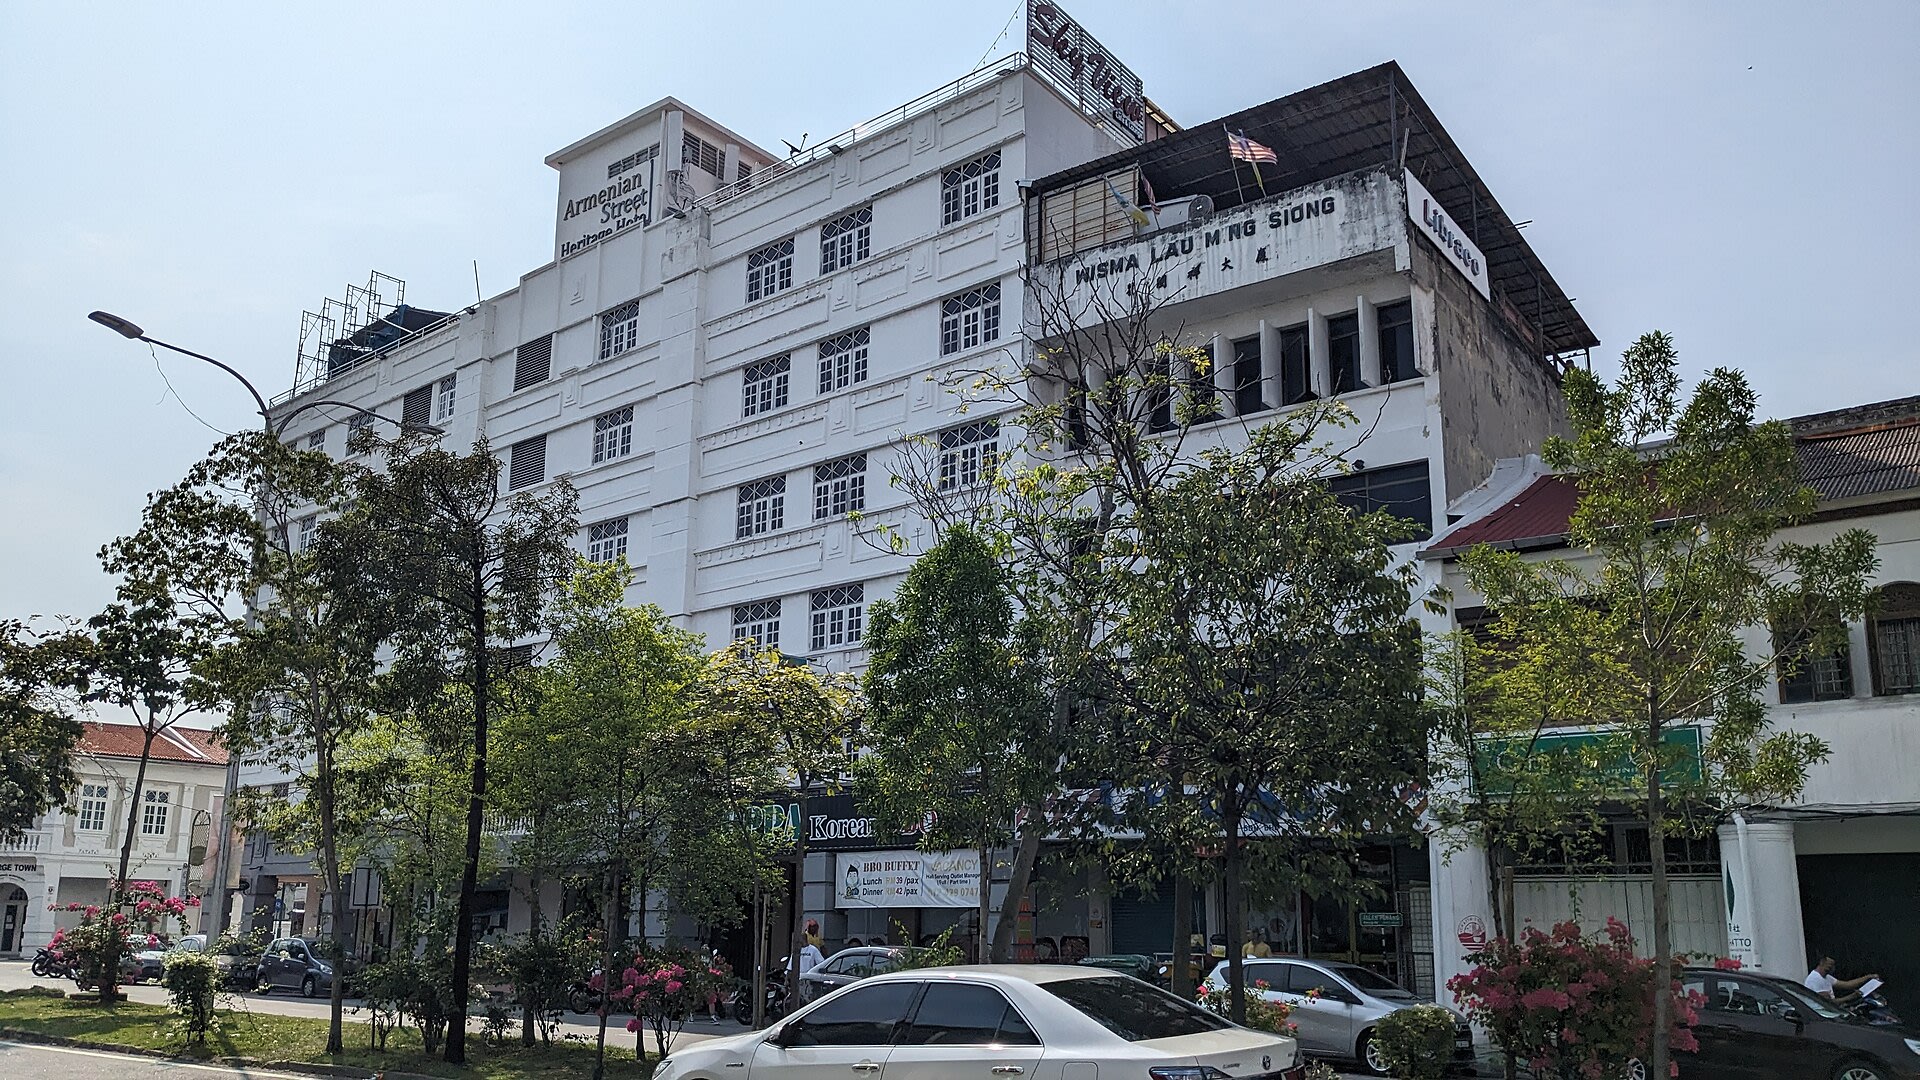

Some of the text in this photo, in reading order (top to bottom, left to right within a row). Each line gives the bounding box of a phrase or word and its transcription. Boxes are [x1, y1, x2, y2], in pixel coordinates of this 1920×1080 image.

[563, 172, 643, 221] Armenian
[600, 187, 649, 224] Street
[1075, 253, 1140, 286] WISMA
[1151, 237, 1194, 265] LAU
[1204, 219, 1256, 248] MNG
[1268, 196, 1335, 230] SIONG
[14, 863, 37, 872] TOWN
[863, 860, 920, 873] BBQ BUFFET
[862, 876, 883, 886] Lunch
[862, 887, 884, 896] Dinner
